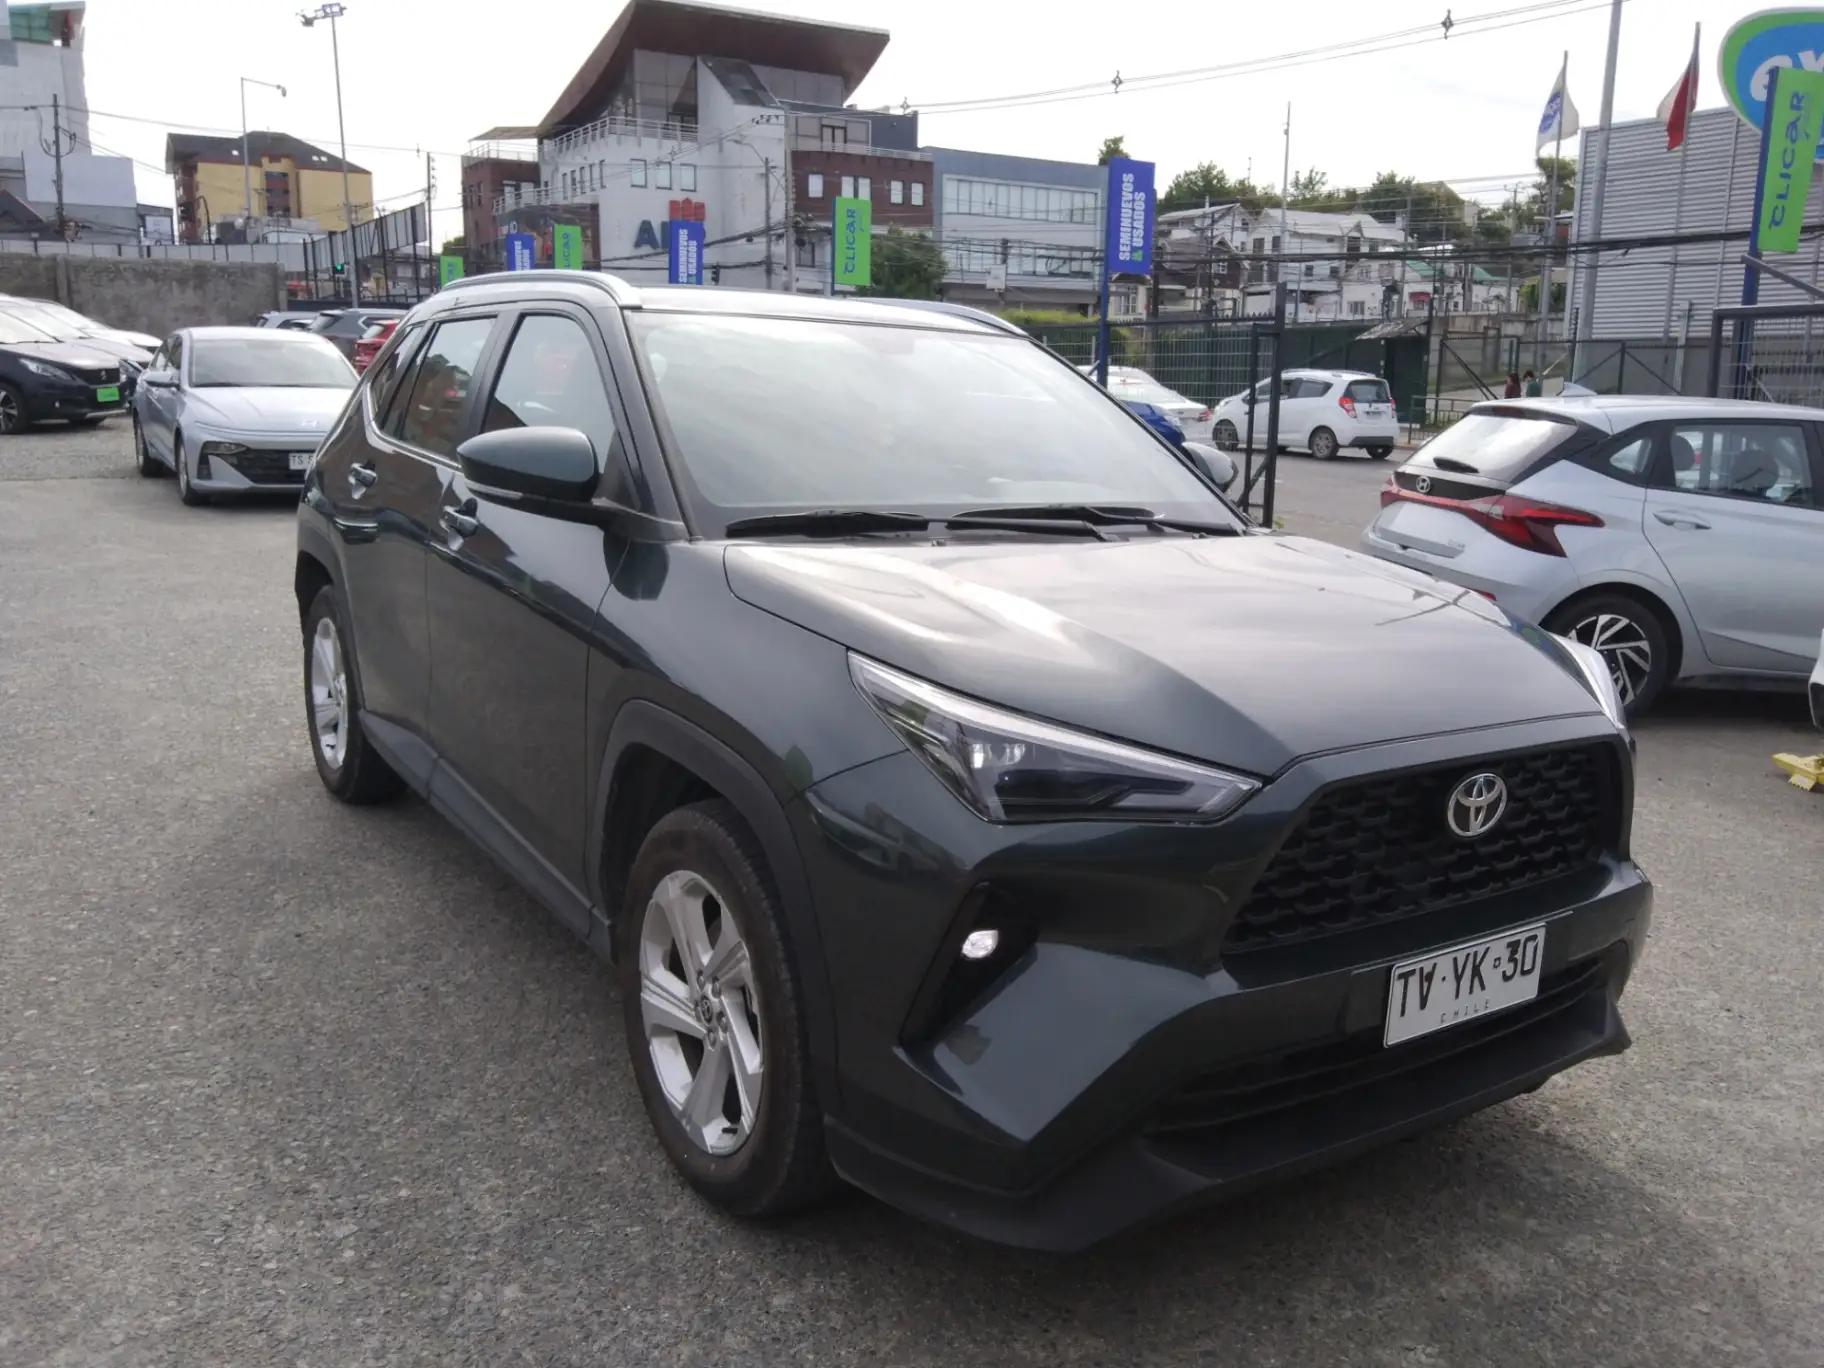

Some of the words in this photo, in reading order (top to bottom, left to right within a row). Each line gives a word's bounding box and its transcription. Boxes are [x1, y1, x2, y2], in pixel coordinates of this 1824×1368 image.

[1119, 173, 1134, 261] SEMINUEVOS
[1132, 191, 1146, 247] USADOS
[1440, 999, 1490, 1024] CHILE
